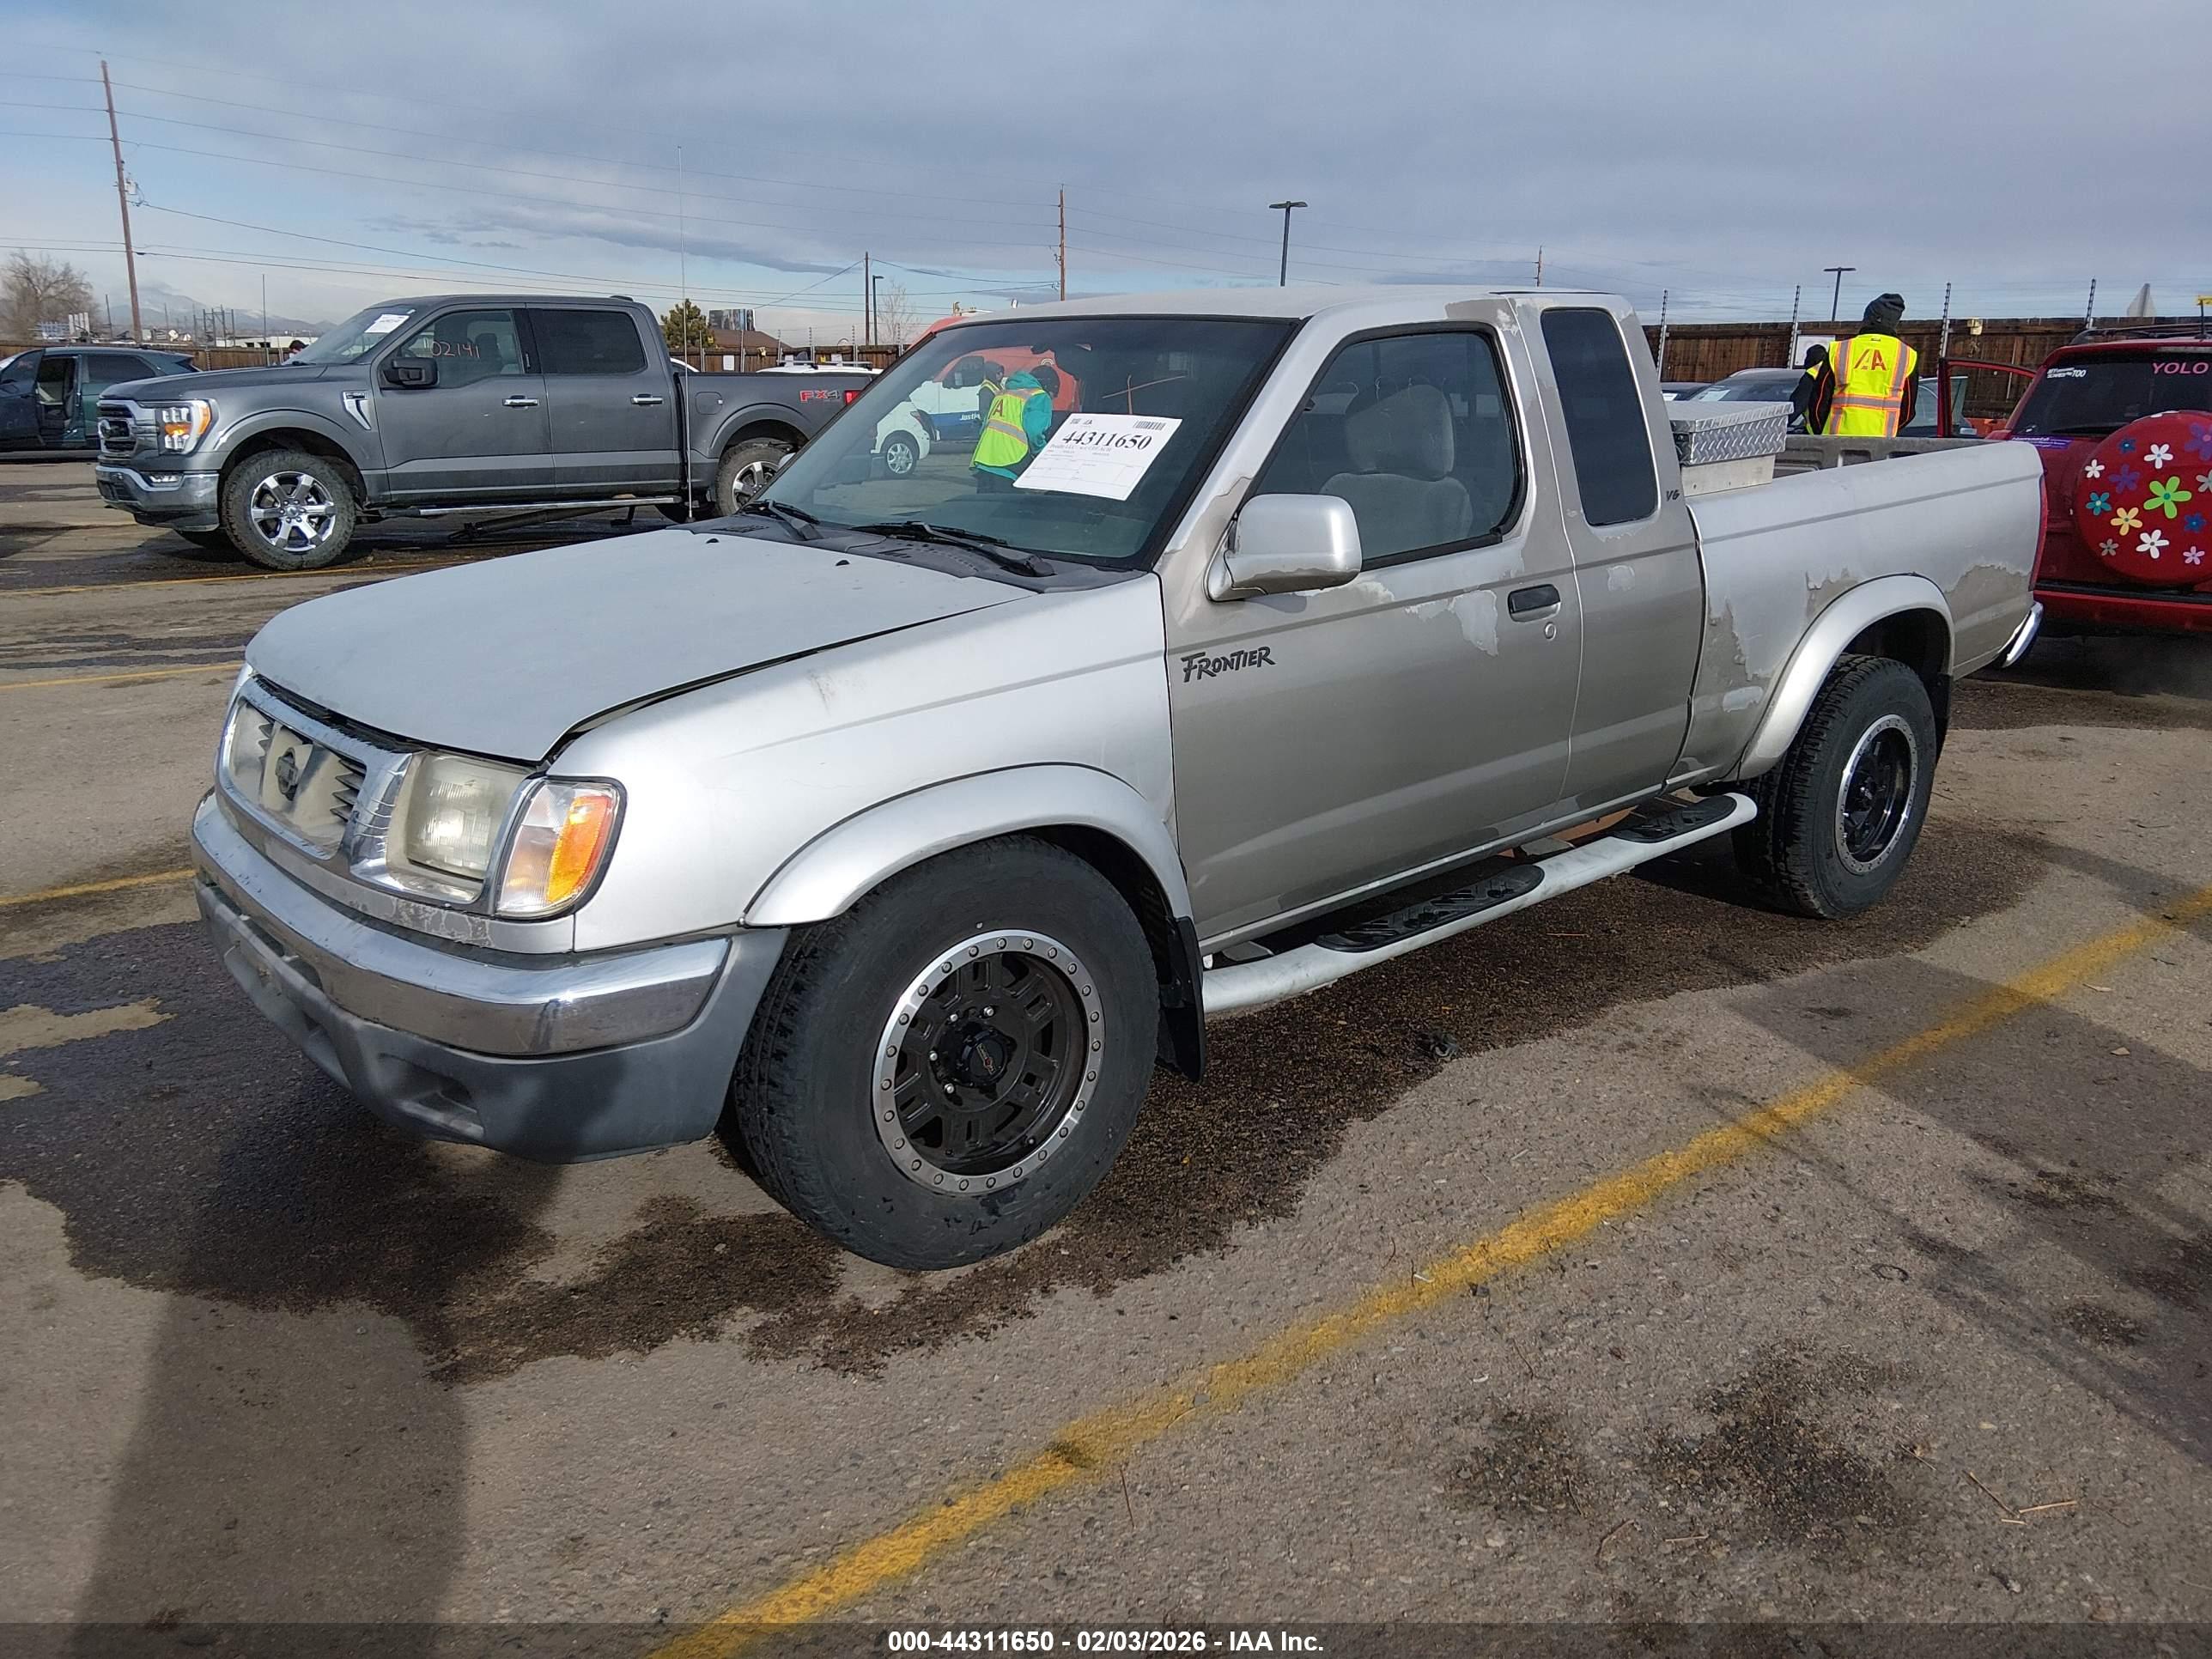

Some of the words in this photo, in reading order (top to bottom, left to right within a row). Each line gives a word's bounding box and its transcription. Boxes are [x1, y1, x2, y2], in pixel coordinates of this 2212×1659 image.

[2071, 369, 2087, 378] TOO
[2153, 362, 2209, 374] YOLO
[799, 390, 839, 403] FX4
[1062, 430, 1152, 450] 44311650
[1666, 489, 1680, 501] V6
